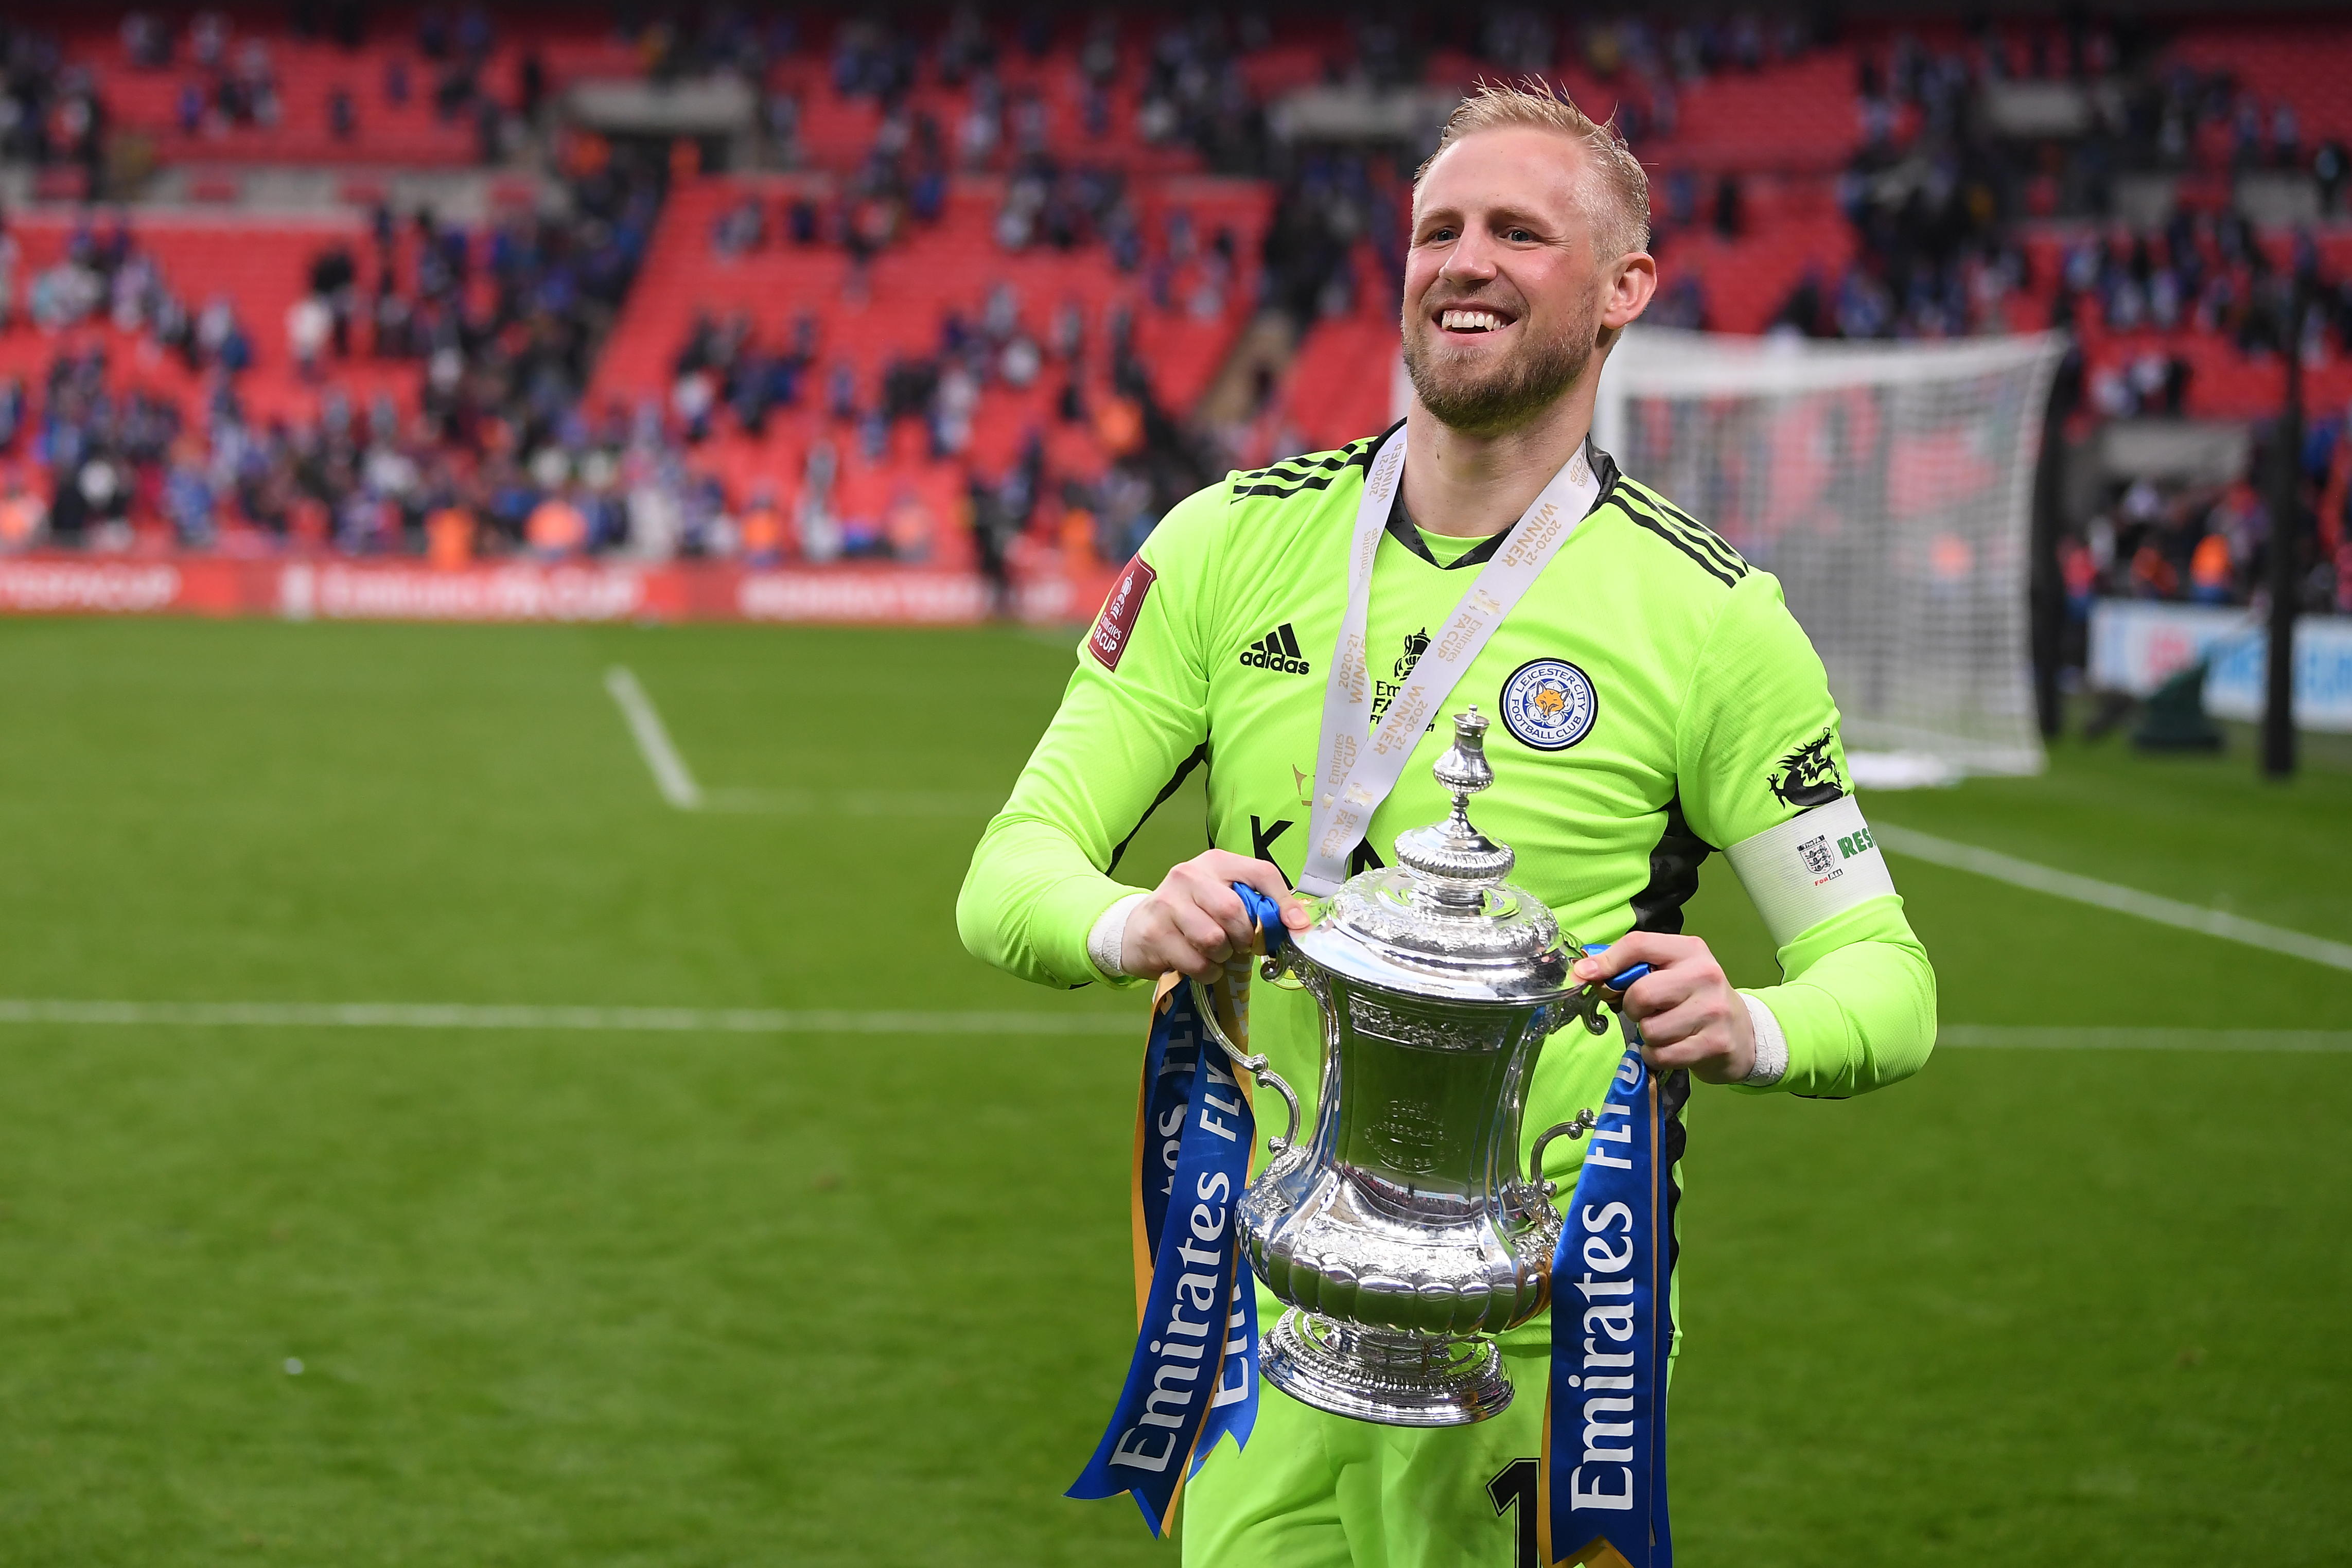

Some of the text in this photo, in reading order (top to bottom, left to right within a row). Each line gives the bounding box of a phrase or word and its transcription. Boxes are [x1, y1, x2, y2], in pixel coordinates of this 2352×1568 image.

[1369, 453, 1391, 497] 2020-21
[1377, 442, 1405, 504] WINNER
[1570, 457, 1583, 483] CUP
[1502, 503, 1559, 568] WINNER
[1523, 519, 1562, 566] 2020-21
[1099, 632, 1117, 654] CUP
[1100, 611, 1122, 640] Emirates
[1437, 613, 1472, 659] FA CUP
[1446, 620, 1483, 663] Emirates
[1240, 651, 1310, 675] adidas
[1338, 633, 1360, 689] 2020-21
[1349, 638, 1366, 703] WINN
[1515, 668, 1586, 711] LEICESTER CITY
[1374, 685, 1426, 755] WINNER
[1393, 700, 1429, 751] 2020-21
[1512, 698, 1582, 739] FOOTBALL CLUB
[1328, 732, 1344, 785] Emirates
[1343, 735, 1357, 768] CUP
[1321, 808, 1349, 858] FA CUP
[1327, 813, 1359, 859] Emirates
[1836, 827, 1876, 859] RES
[1108, 1171, 1230, 1472] Emirates
[1199, 1059, 1241, 1142] FLY
[1568, 1201, 1635, 1511] Emirates
